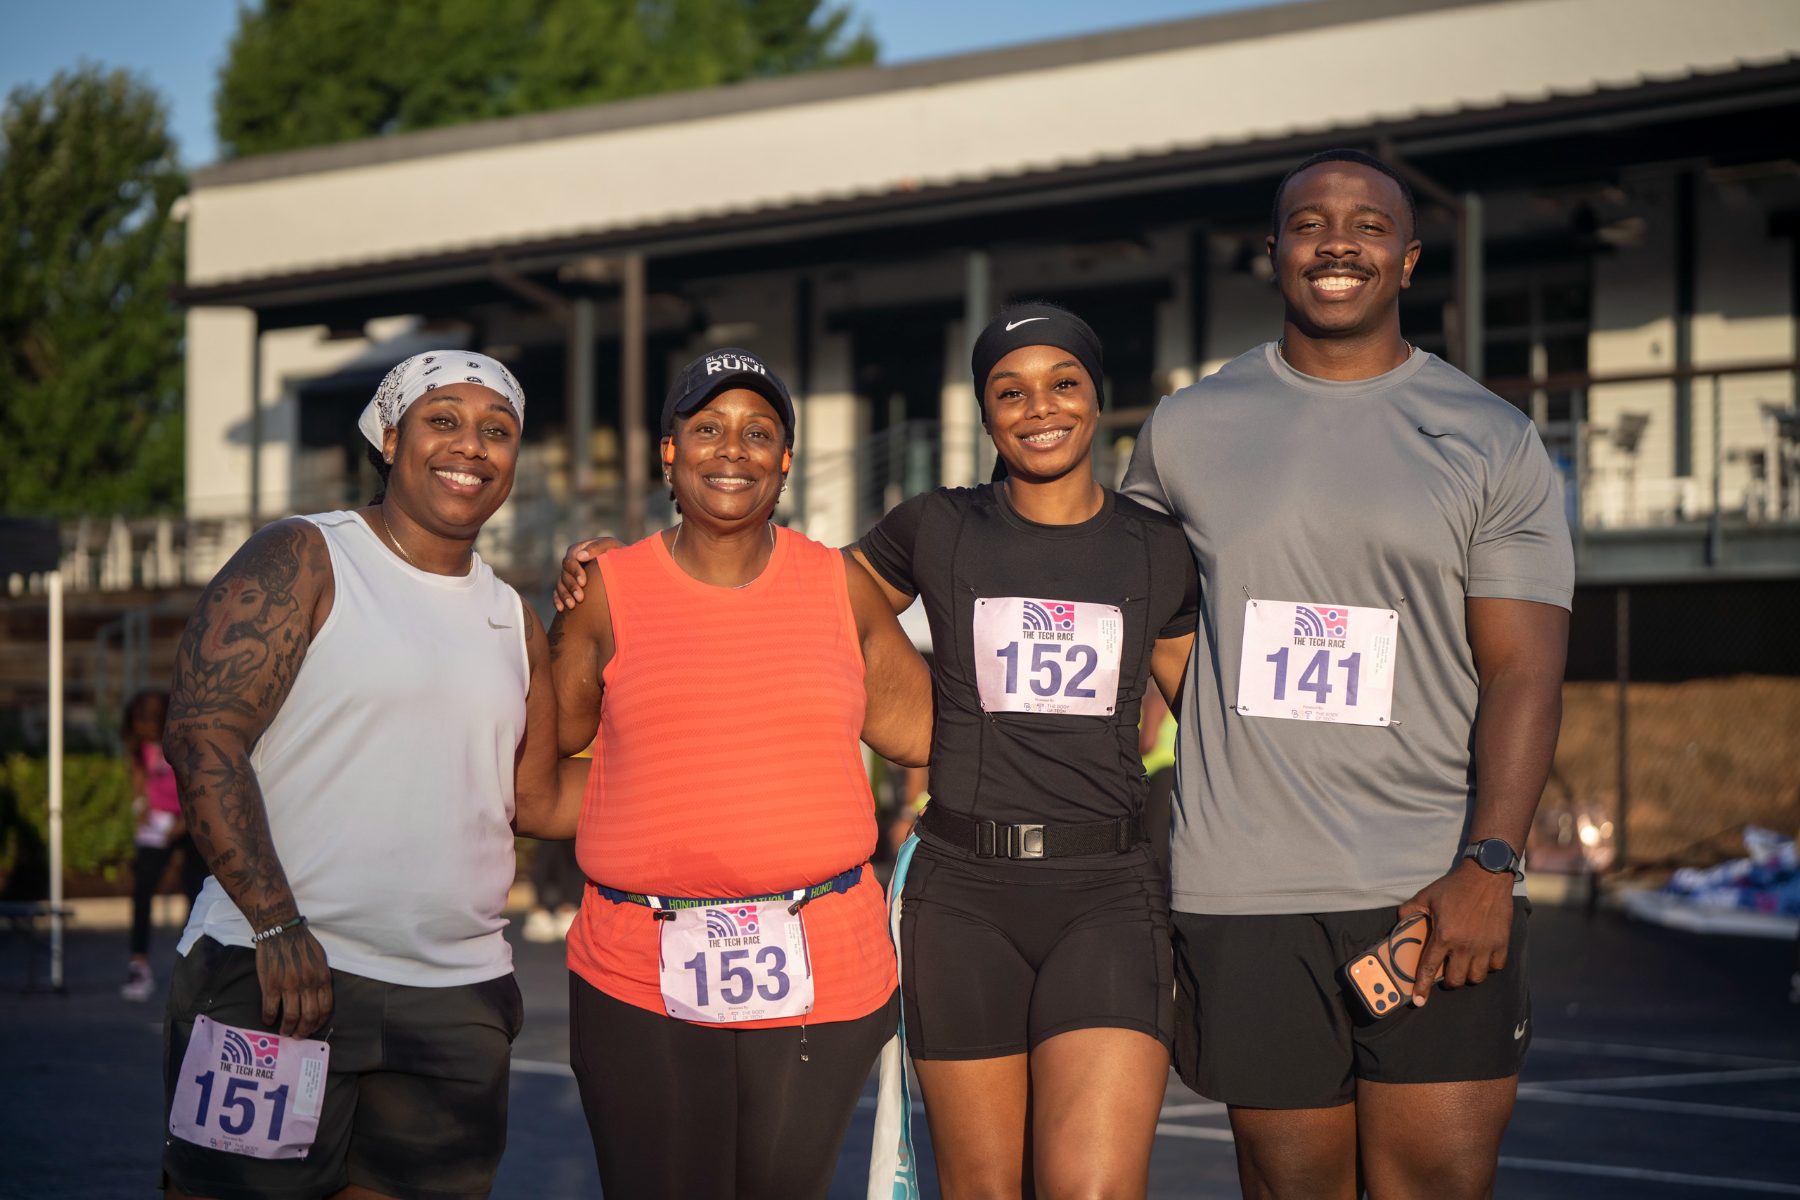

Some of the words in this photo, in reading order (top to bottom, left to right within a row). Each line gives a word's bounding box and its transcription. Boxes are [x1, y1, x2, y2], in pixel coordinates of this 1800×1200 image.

[706, 353, 737, 363] BLACK
[1022, 630, 1035, 639] THE
[1038, 631, 1054, 640] TECH
[1056, 632, 1074, 641] RACE
[1293, 636, 1306, 646] THE
[1309, 637, 1326, 647] TECH
[1328, 638, 1346, 648] RACE
[996, 641, 1098, 698] 152
[1266, 647, 1361, 706] 141
[708, 939, 721, 949] THE
[724, 937, 741, 947] TECH
[743, 935, 761, 945] RACE
[684, 946, 790, 1007] 153
[219, 1061, 232, 1073] THE
[235, 1066, 254, 1077] TECH
[255, 1069, 275, 1080] RACE
[195, 1070, 289, 1142] 151
